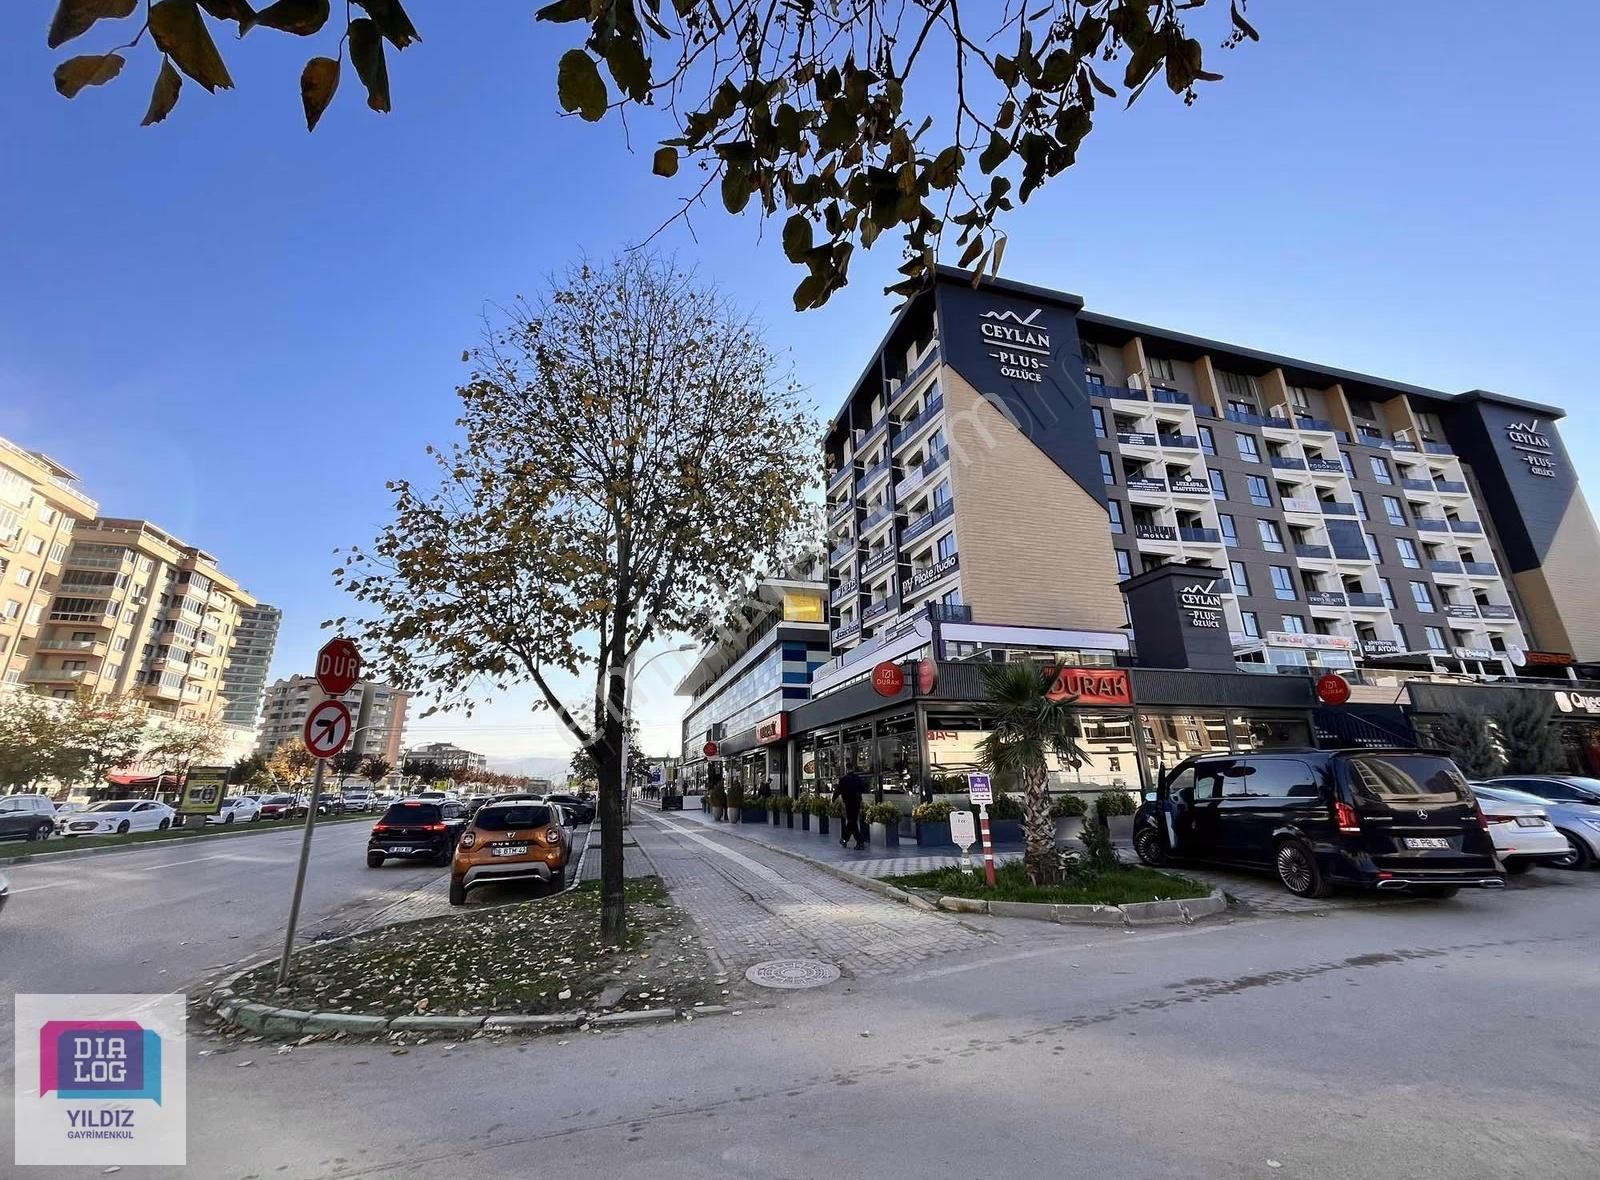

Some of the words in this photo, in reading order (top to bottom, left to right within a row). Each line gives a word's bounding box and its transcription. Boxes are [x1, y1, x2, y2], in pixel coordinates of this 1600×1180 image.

[981, 323, 1050, 348] CEYLAN
[1000, 365, 1042, 383] ÖZLÜCE
[1509, 431, 1550, 448] CEYLAN
[1181, 593, 1221, 606] CEYLAN
[320, 654, 357, 679] DUR
[876, 678, 900, 686] DURAK
[1048, 674, 1126, 697] DURAK
